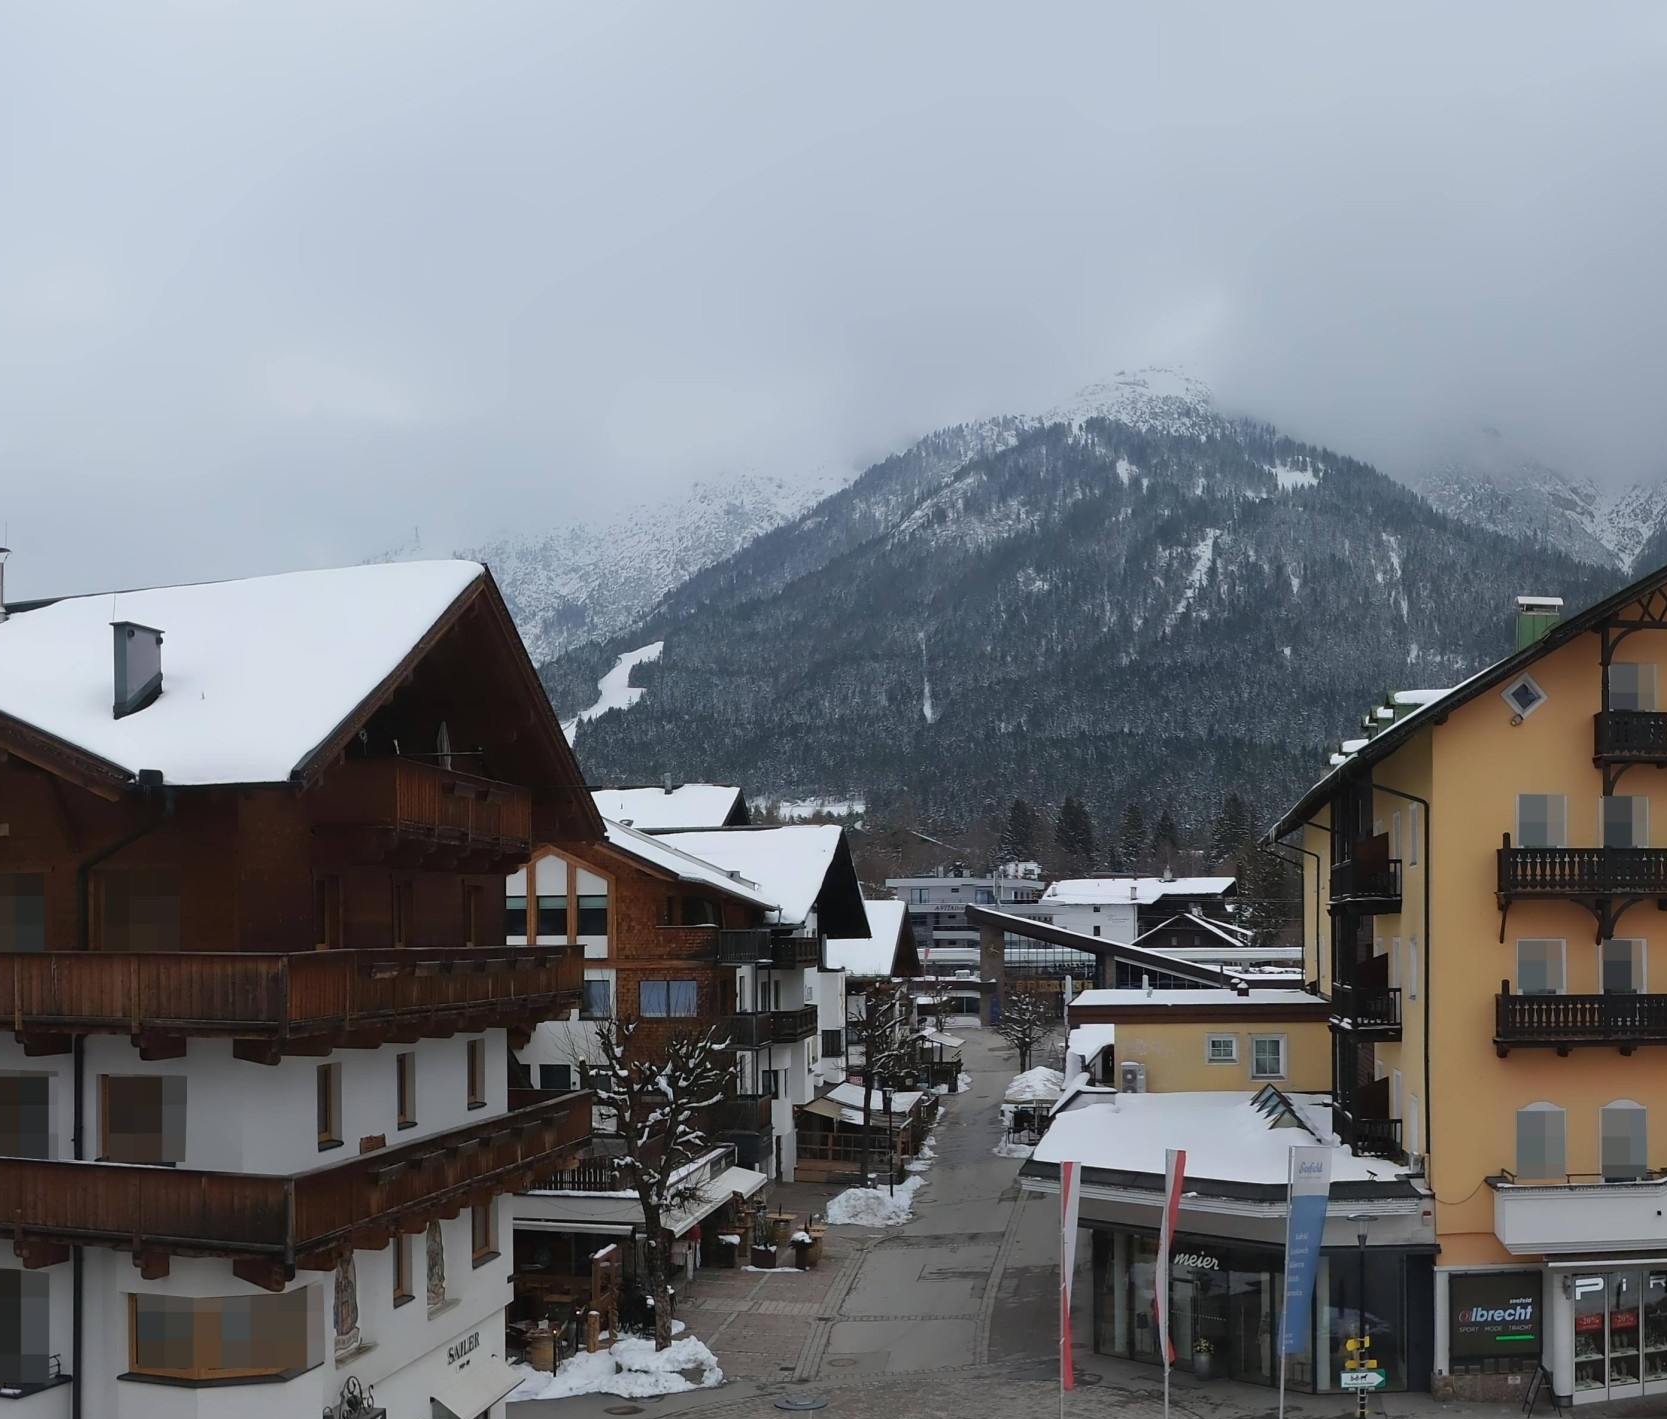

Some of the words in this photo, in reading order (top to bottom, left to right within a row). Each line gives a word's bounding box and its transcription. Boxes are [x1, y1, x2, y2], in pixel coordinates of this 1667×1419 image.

[1298, 1161, 1323, 1175] Seefeld
[1173, 1250, 1220, 1270] meier
[1458, 1305, 1533, 1322] albrecht
